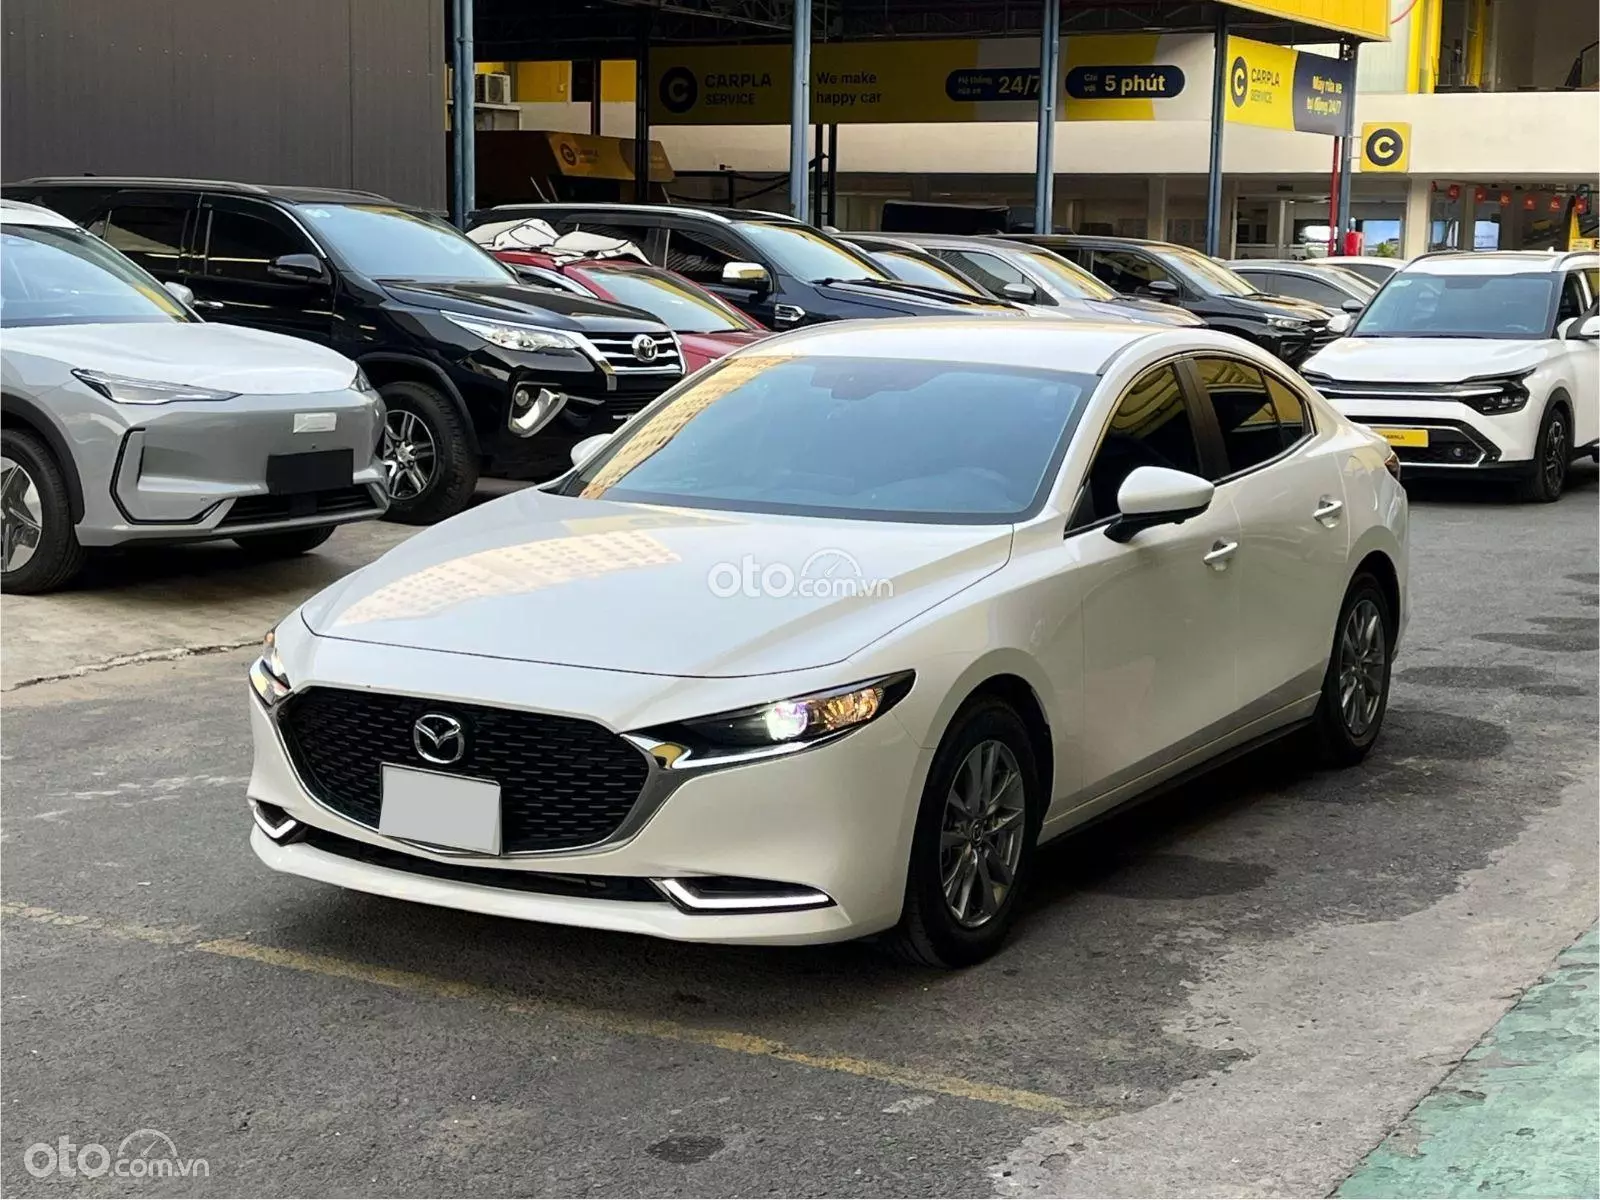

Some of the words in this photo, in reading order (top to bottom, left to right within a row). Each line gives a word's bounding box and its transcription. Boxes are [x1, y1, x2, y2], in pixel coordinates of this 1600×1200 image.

[704, 73, 772, 88] CARPLA
[816, 72, 837, 85] We
[841, 72, 877, 85] make
[998, 74, 1040, 95] 24/7
[1104, 74, 1117, 92] 5
[1120, 73, 1166, 96] phút
[1250, 68, 1280, 88] CARPLA
[705, 92, 756, 106] SERVICE
[816, 91, 857, 107] happy
[860, 92, 882, 104] car
